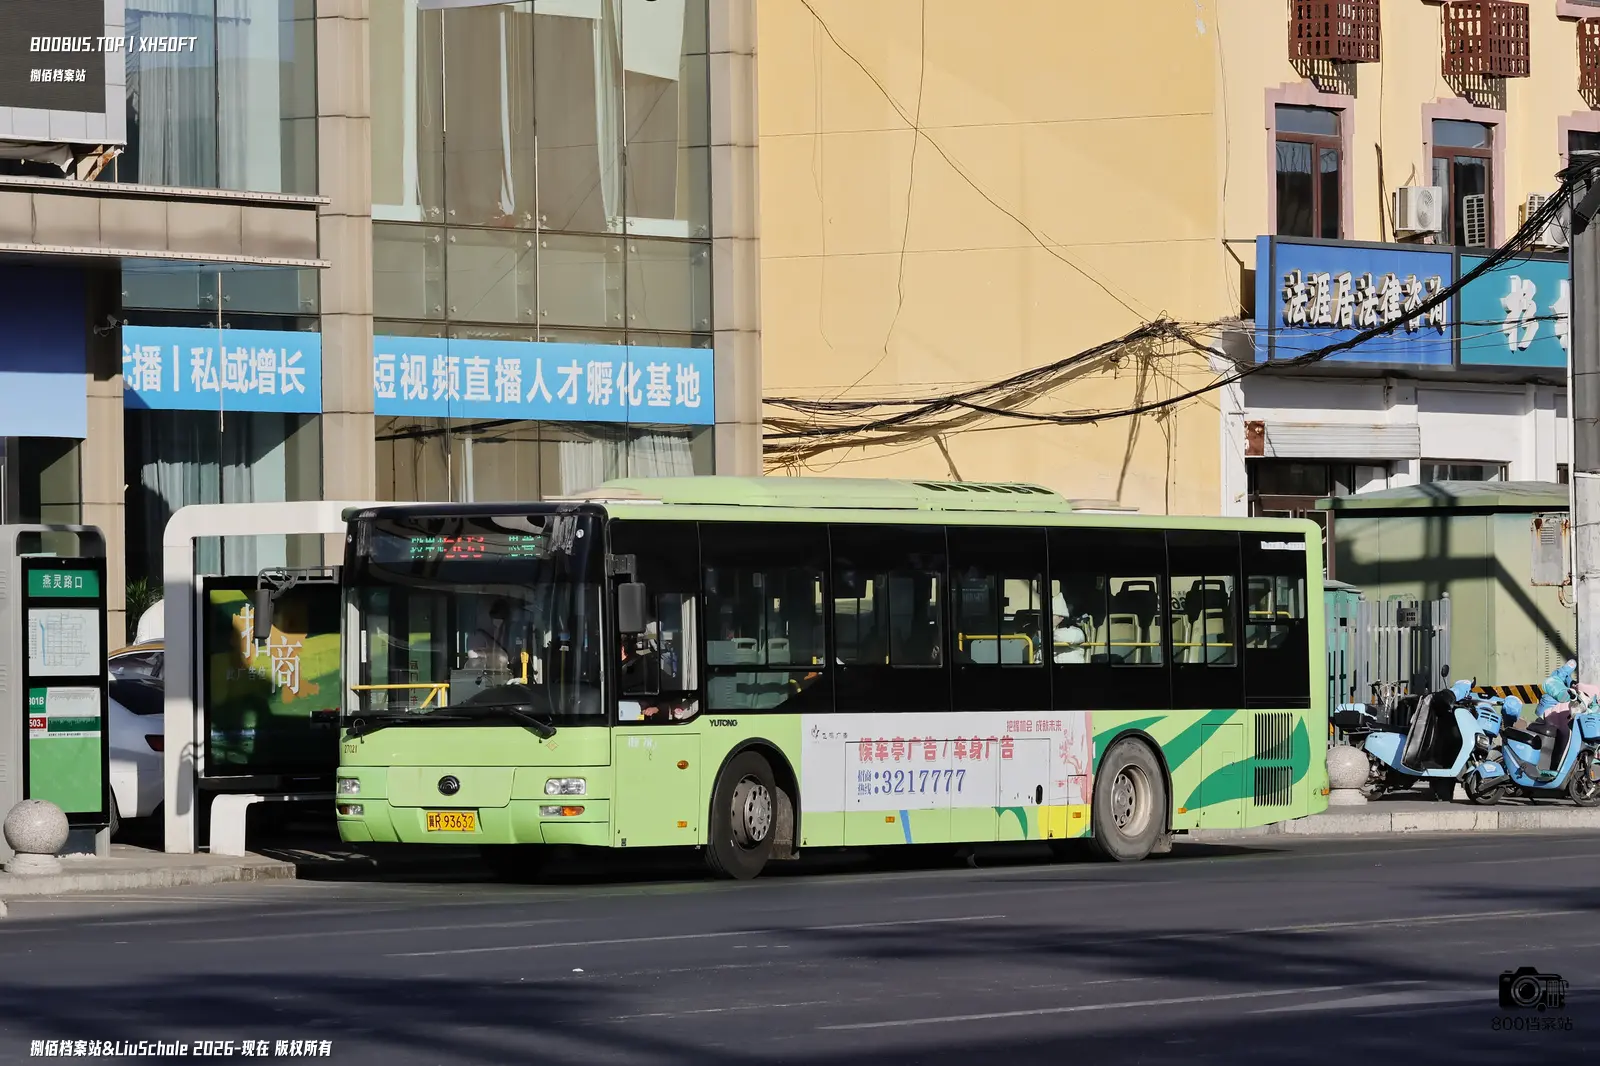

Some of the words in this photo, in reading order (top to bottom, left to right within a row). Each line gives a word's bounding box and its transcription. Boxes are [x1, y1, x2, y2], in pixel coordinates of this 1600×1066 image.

[374, 353, 701, 408] 短视频直播人才孵化基地
[42, 574, 83, 589] 燕灵路口
[709, 719, 738, 727] YUTONG
